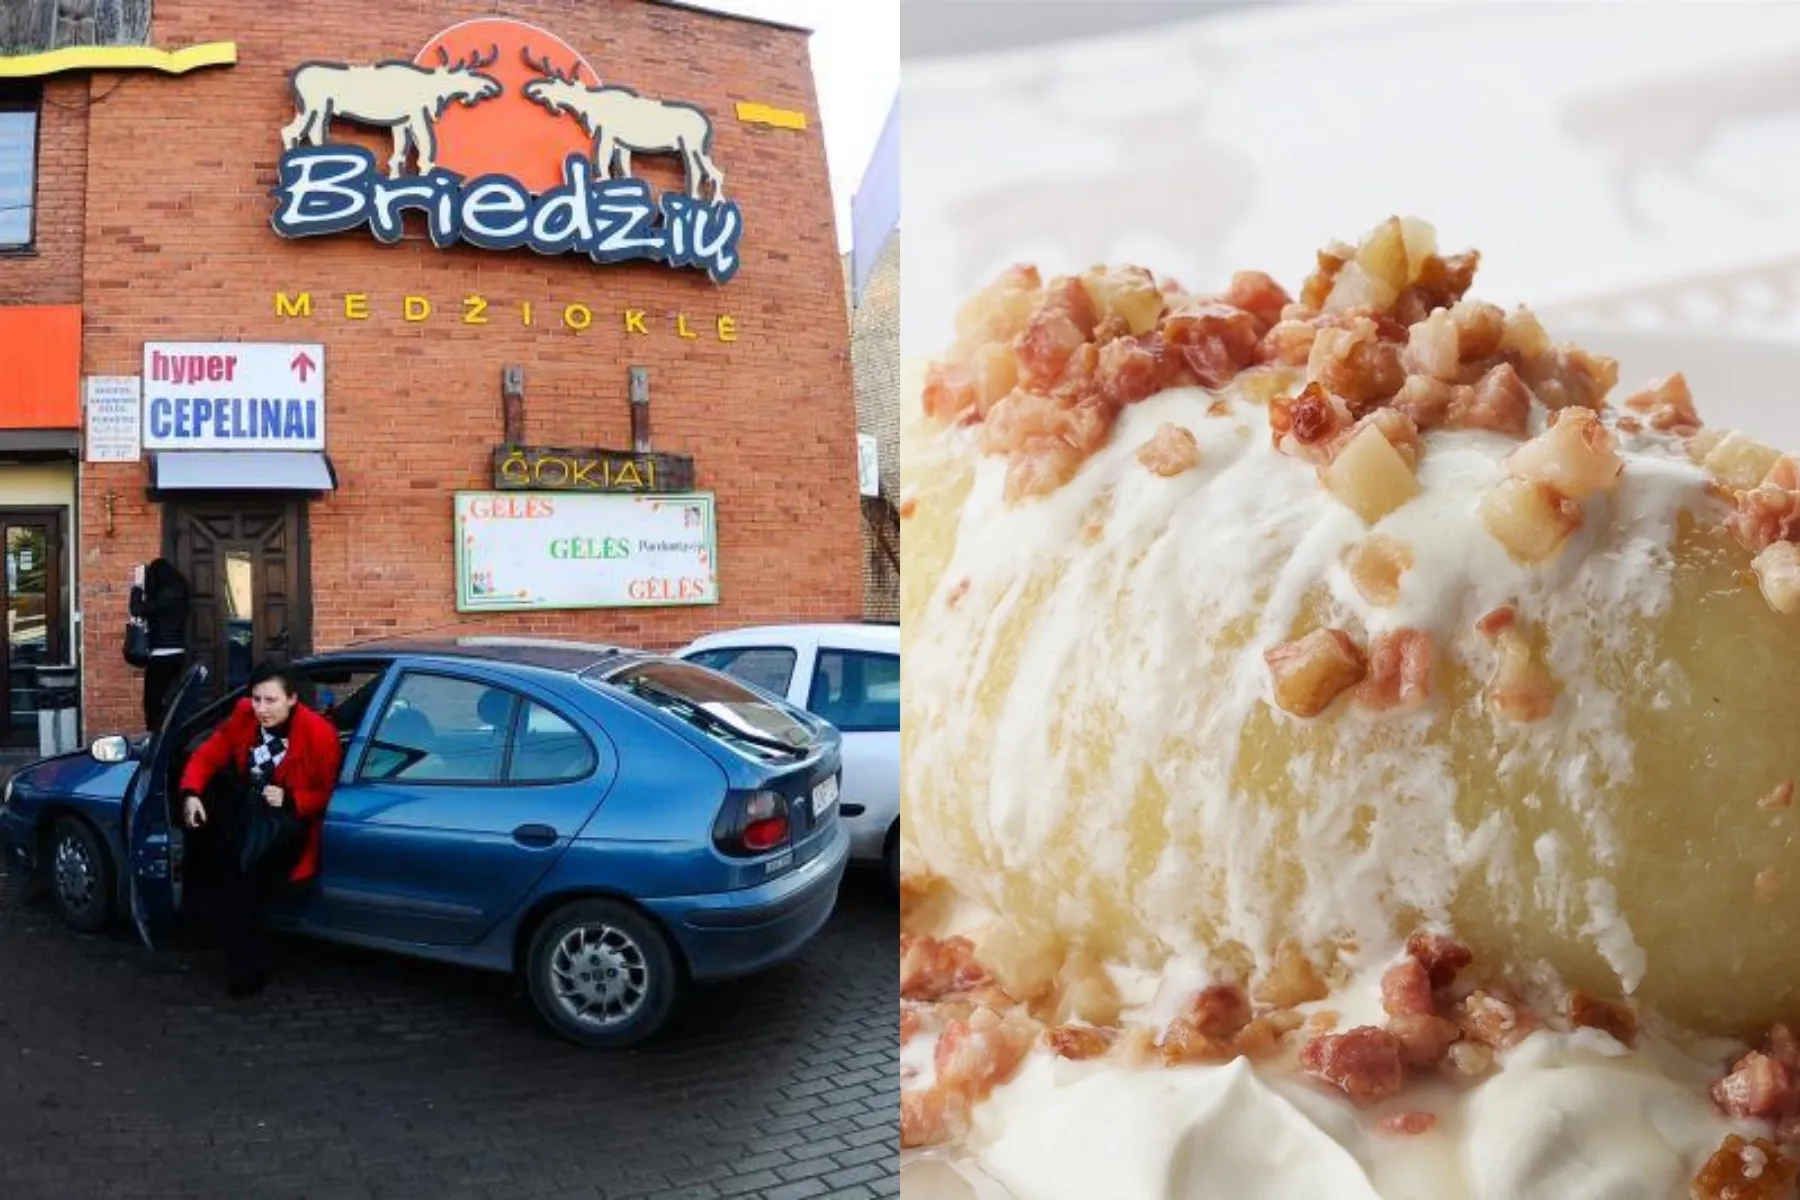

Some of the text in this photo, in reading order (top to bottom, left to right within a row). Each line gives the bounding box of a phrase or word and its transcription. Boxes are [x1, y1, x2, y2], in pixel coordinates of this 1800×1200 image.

[281, 154, 736, 272] Briedžių
[152, 350, 238, 385] hyper
[150, 397, 316, 440] CEPELINAI
[470, 494, 556, 518] GĖLĖS
[549, 535, 630, 559] GĖLĖS
[628, 576, 704, 599] GĖLĖS
